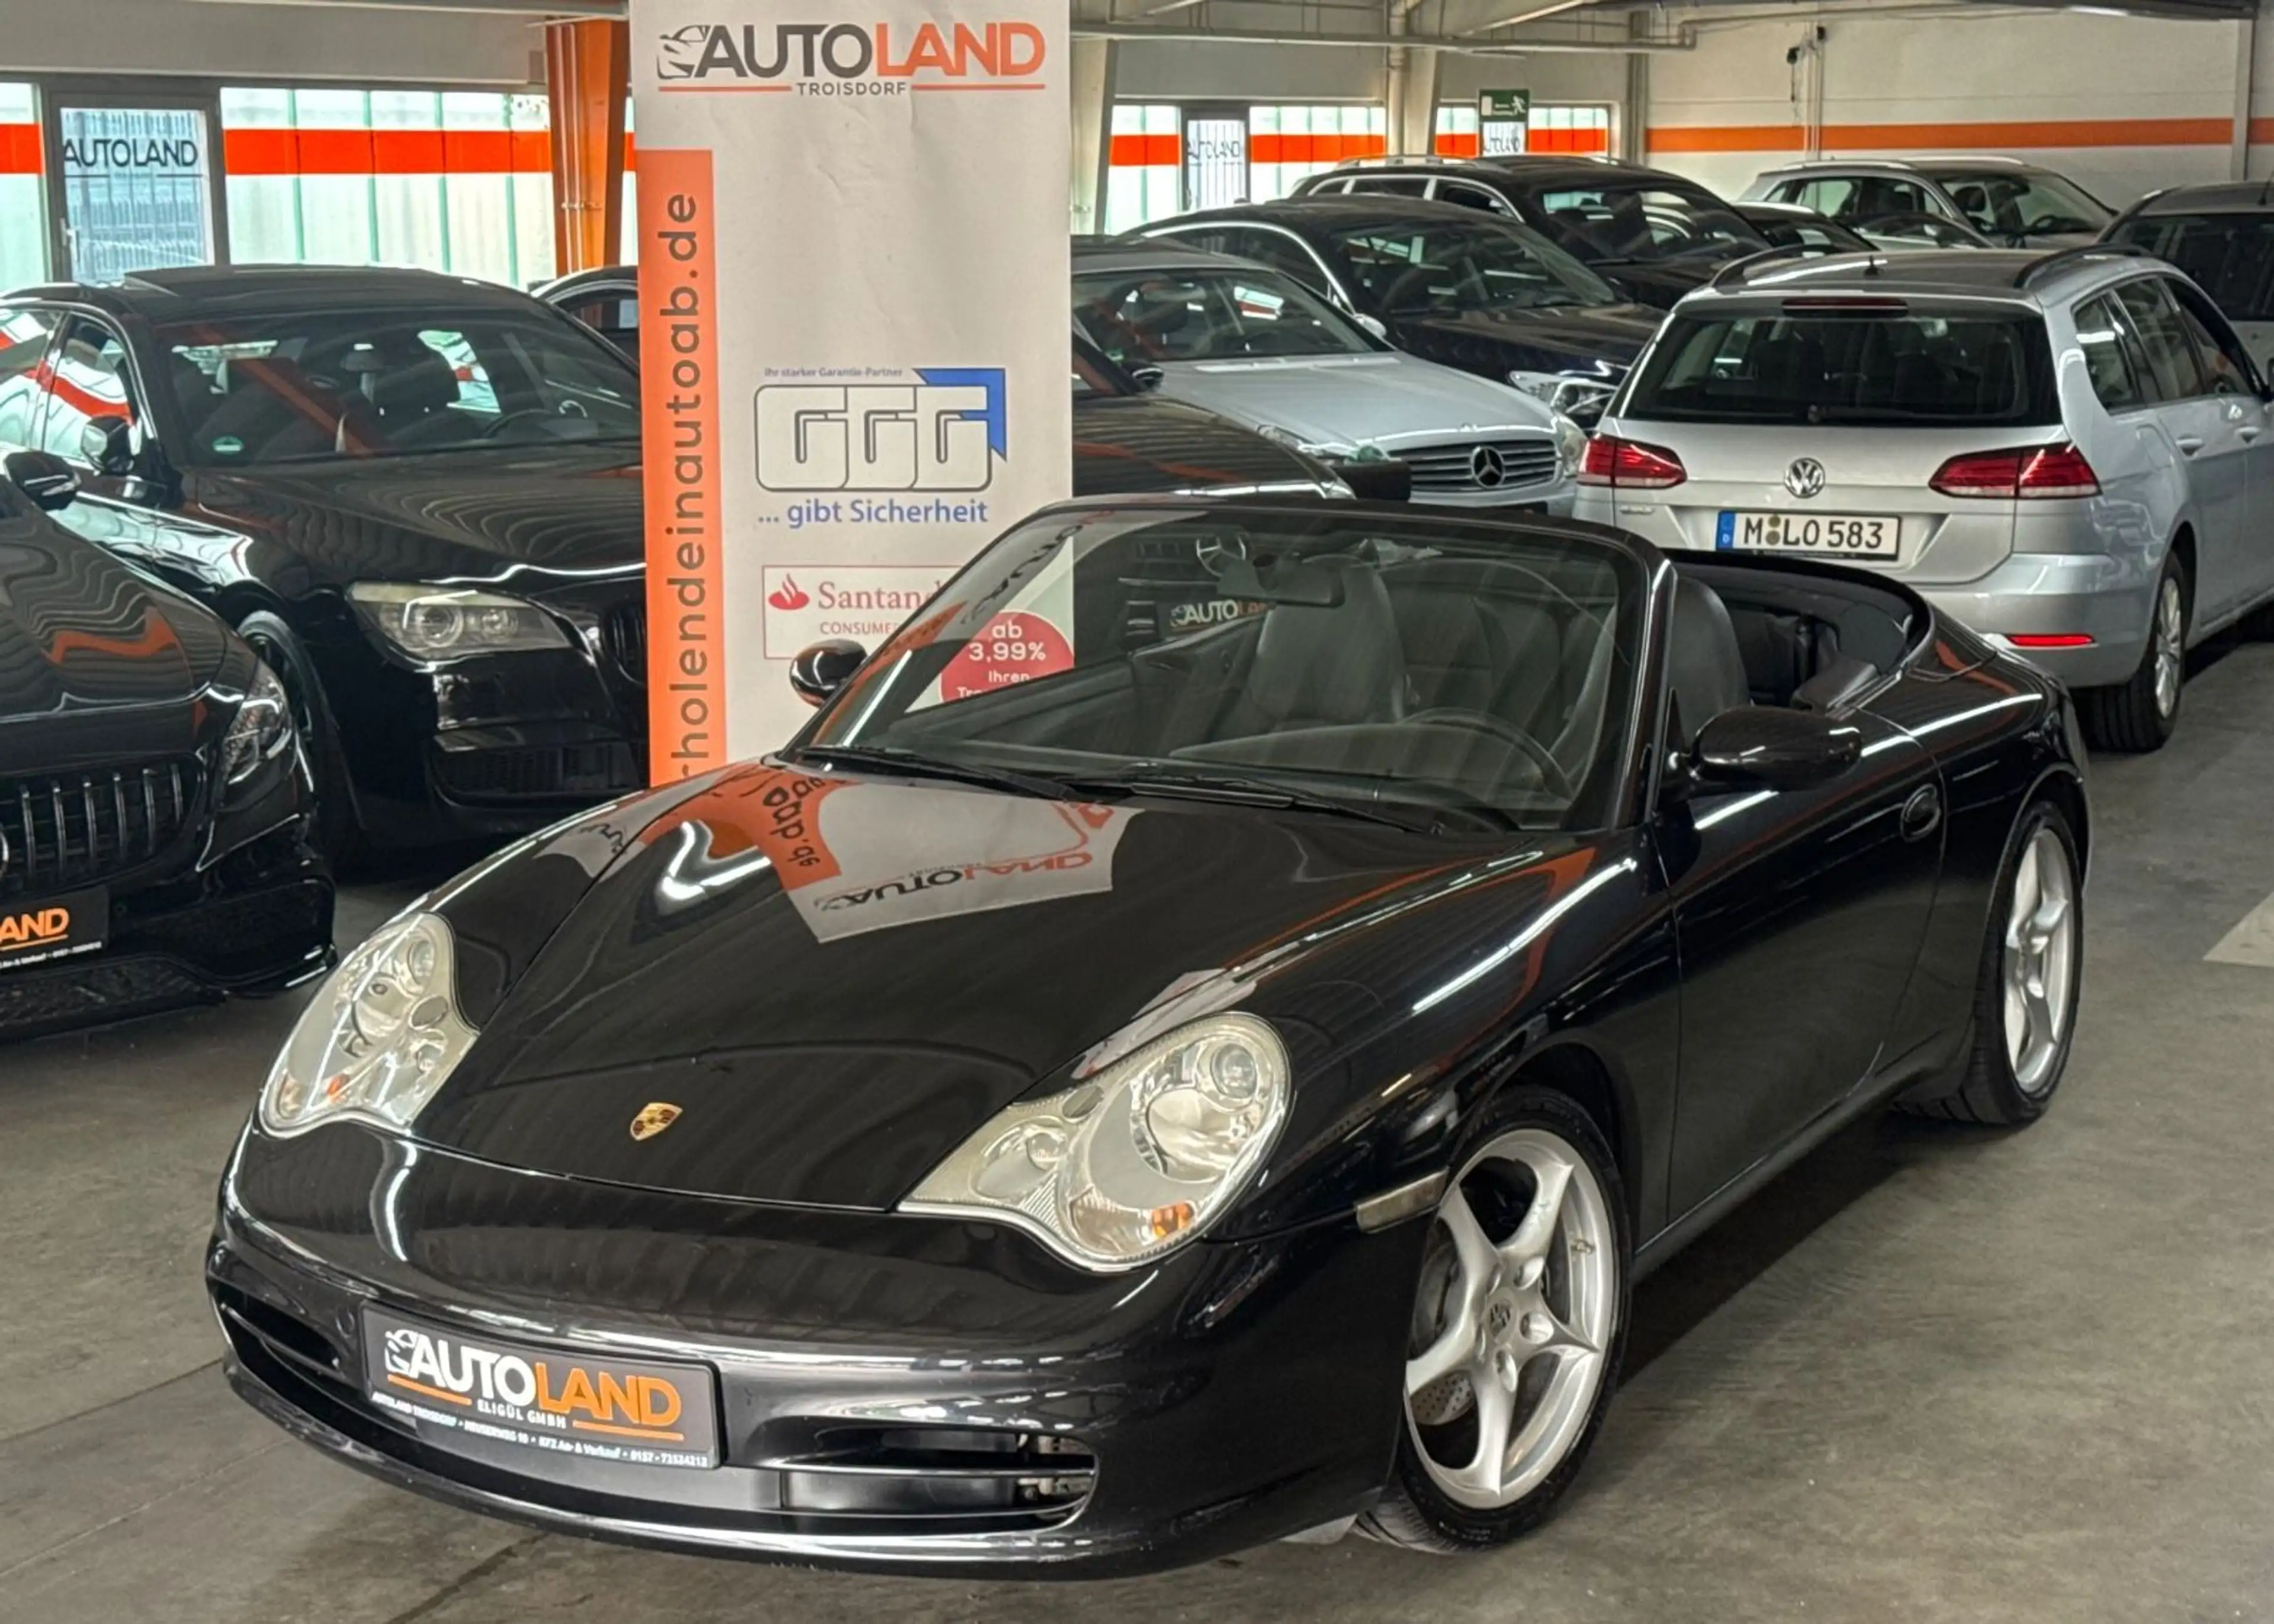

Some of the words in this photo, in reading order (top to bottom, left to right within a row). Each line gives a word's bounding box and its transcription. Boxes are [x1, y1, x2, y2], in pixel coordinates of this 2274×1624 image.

[694, 22, 1046, 78] AUTOLAND
[797, 82, 907, 96] TROISDORF
[64, 139, 199, 168] AUTOLAND
[781, 367, 816, 377] starker
[787, 499, 842, 529] gibt
[850, 499, 989, 523] Sicherheit
[1743, 517, 1764, 545] M
[1782, 518, 1821, 546] LO
[1827, 520, 1884, 549] 583
[991, 620, 1023, 639] ab
[969, 641, 1047, 663] 3,99%
[988, 670, 1031, 683] Ihren
[0, 908, 69, 945] AND
[410, 1332, 682, 1426] AUTOLAND
[527, 1410, 566, 1429] GMBH
